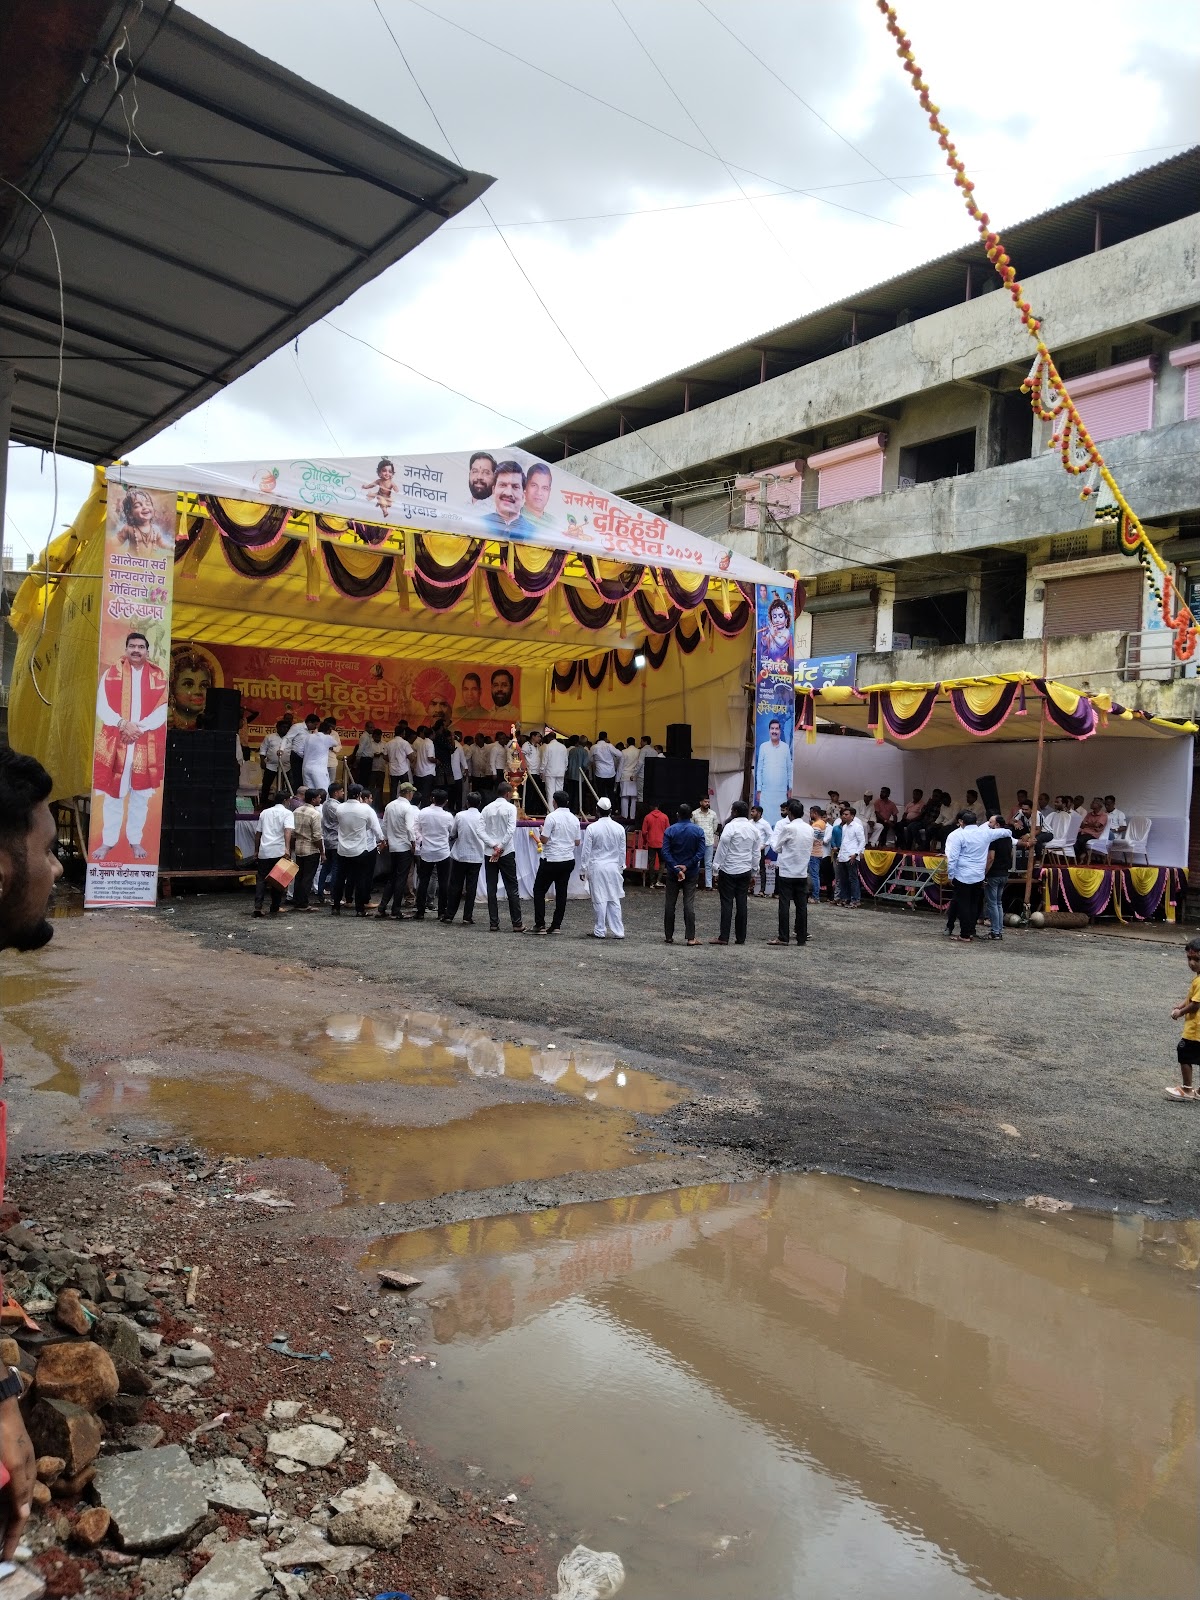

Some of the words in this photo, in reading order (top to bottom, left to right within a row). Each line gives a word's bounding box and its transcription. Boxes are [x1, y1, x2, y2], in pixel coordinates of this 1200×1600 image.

[404, 465, 443, 483] जनसेवा
[402, 482, 448, 502] प्रतिष्ठान
[560, 489, 610, 512] जनसेवा
[402, 502, 437, 519] मुरबाड
[593, 506, 669, 541] दहिहंडी
[600, 531, 664, 557] उत्सव
[111, 553, 149, 568] आलेल्या
[151, 558, 167, 571] सर्व
[110, 569, 156, 584] मान्यवरांचे
[157, 575, 166, 585] व
[109, 582, 149, 597] गोविंदाचे
[135, 604, 164, 619] स्वागत
[269, 653, 300, 666] जनसेवा
[300, 655, 333, 669] प्रतिष्ठान
[335, 660, 360, 672] मुरबाड
[232, 674, 303, 700] जनसेवा
[306, 673, 396, 703] दहिहंडी
[314, 699, 394, 723] उत्सव
